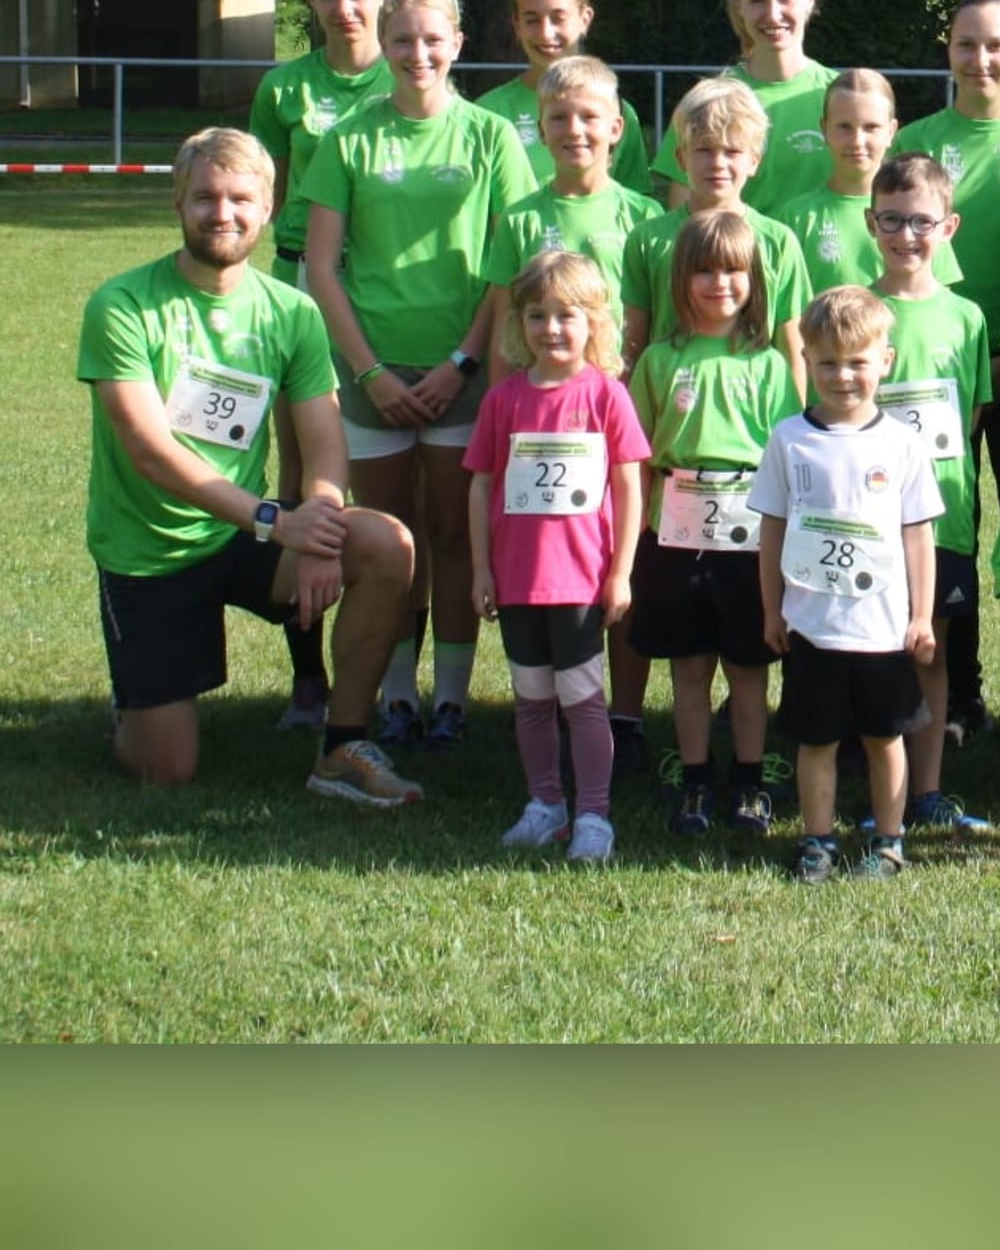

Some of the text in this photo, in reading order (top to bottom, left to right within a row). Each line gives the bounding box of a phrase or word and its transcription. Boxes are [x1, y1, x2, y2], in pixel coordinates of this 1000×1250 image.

[202, 392, 237, 419] 39
[535, 462, 567, 487] 22
[704, 500, 719, 524] 2
[820, 540, 855, 568] 28
